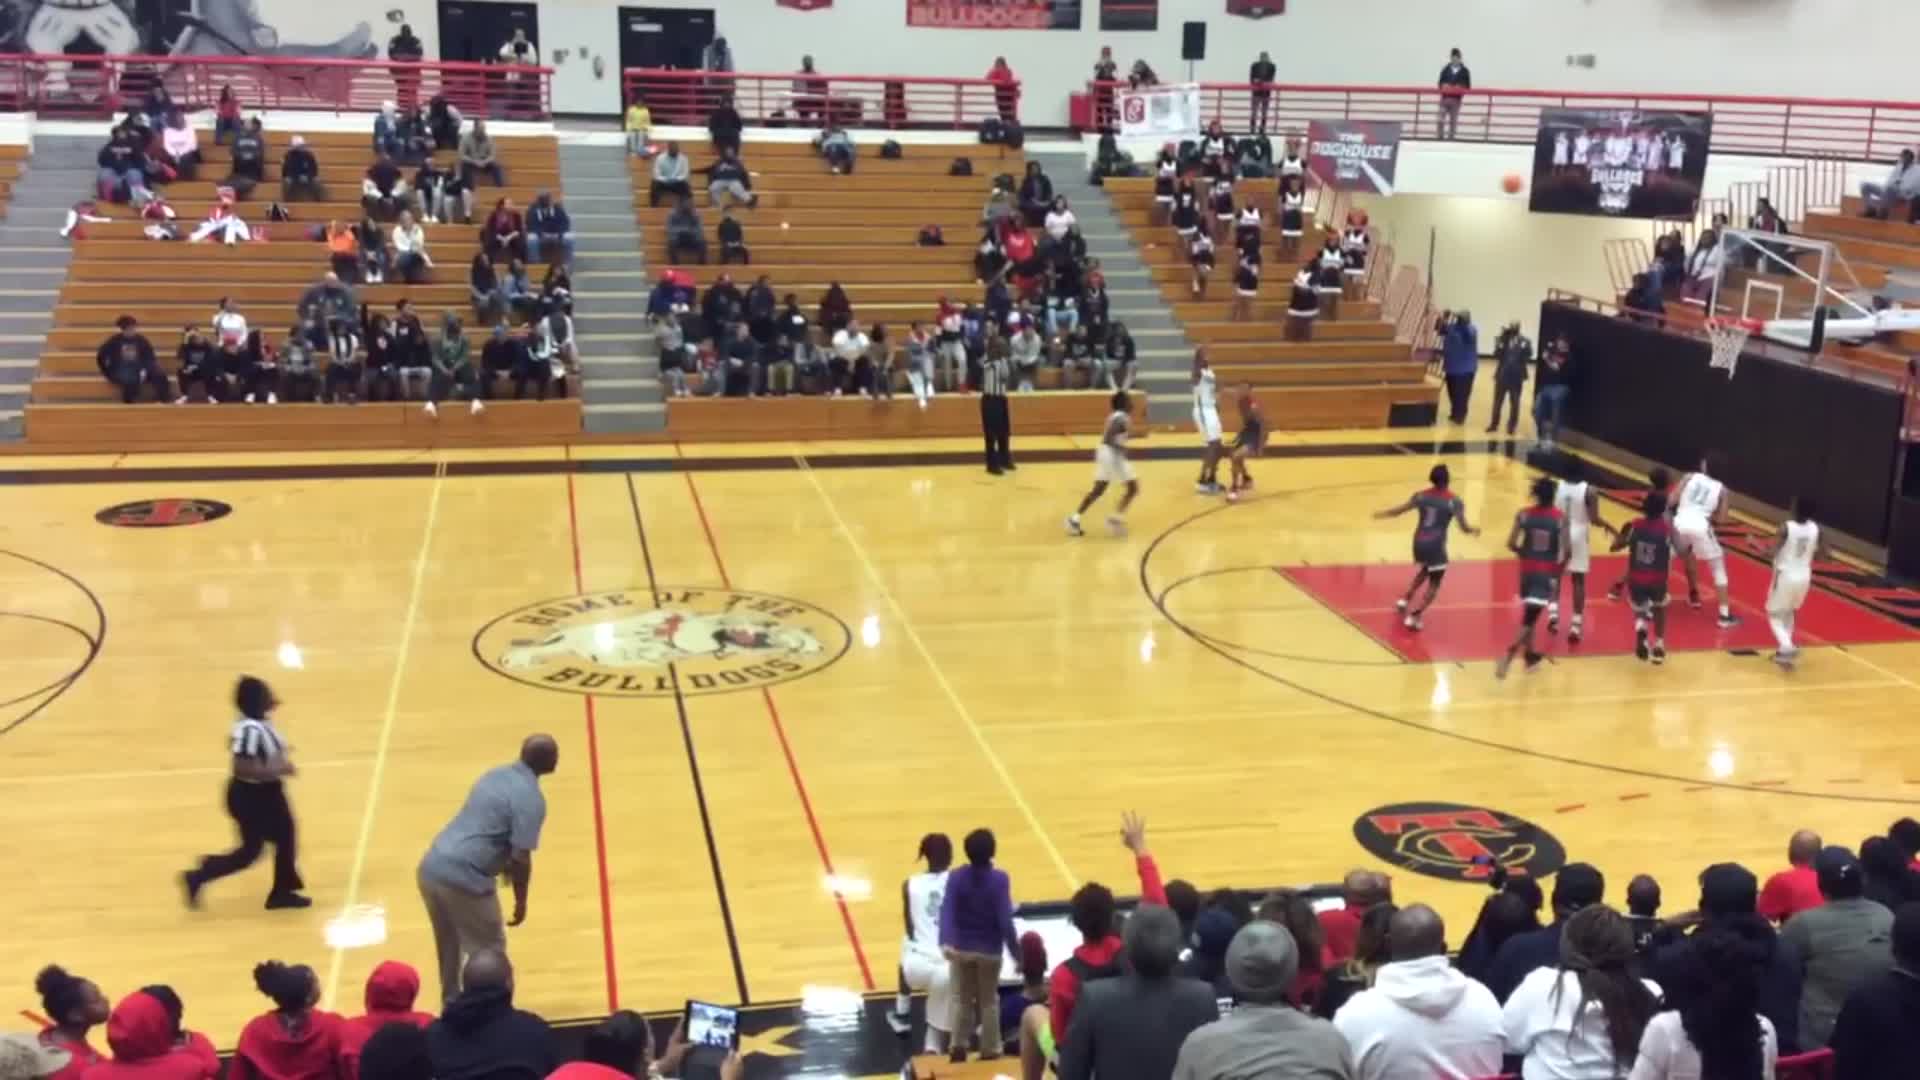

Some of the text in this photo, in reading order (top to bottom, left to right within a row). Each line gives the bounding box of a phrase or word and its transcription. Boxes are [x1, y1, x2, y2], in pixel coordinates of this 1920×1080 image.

[1311, 141, 1393, 160] DOGHOUSE
[512, 594, 634, 627] HOME
[723, 594, 805, 618] THE
[543, 657, 802, 690] BULLDOGS
